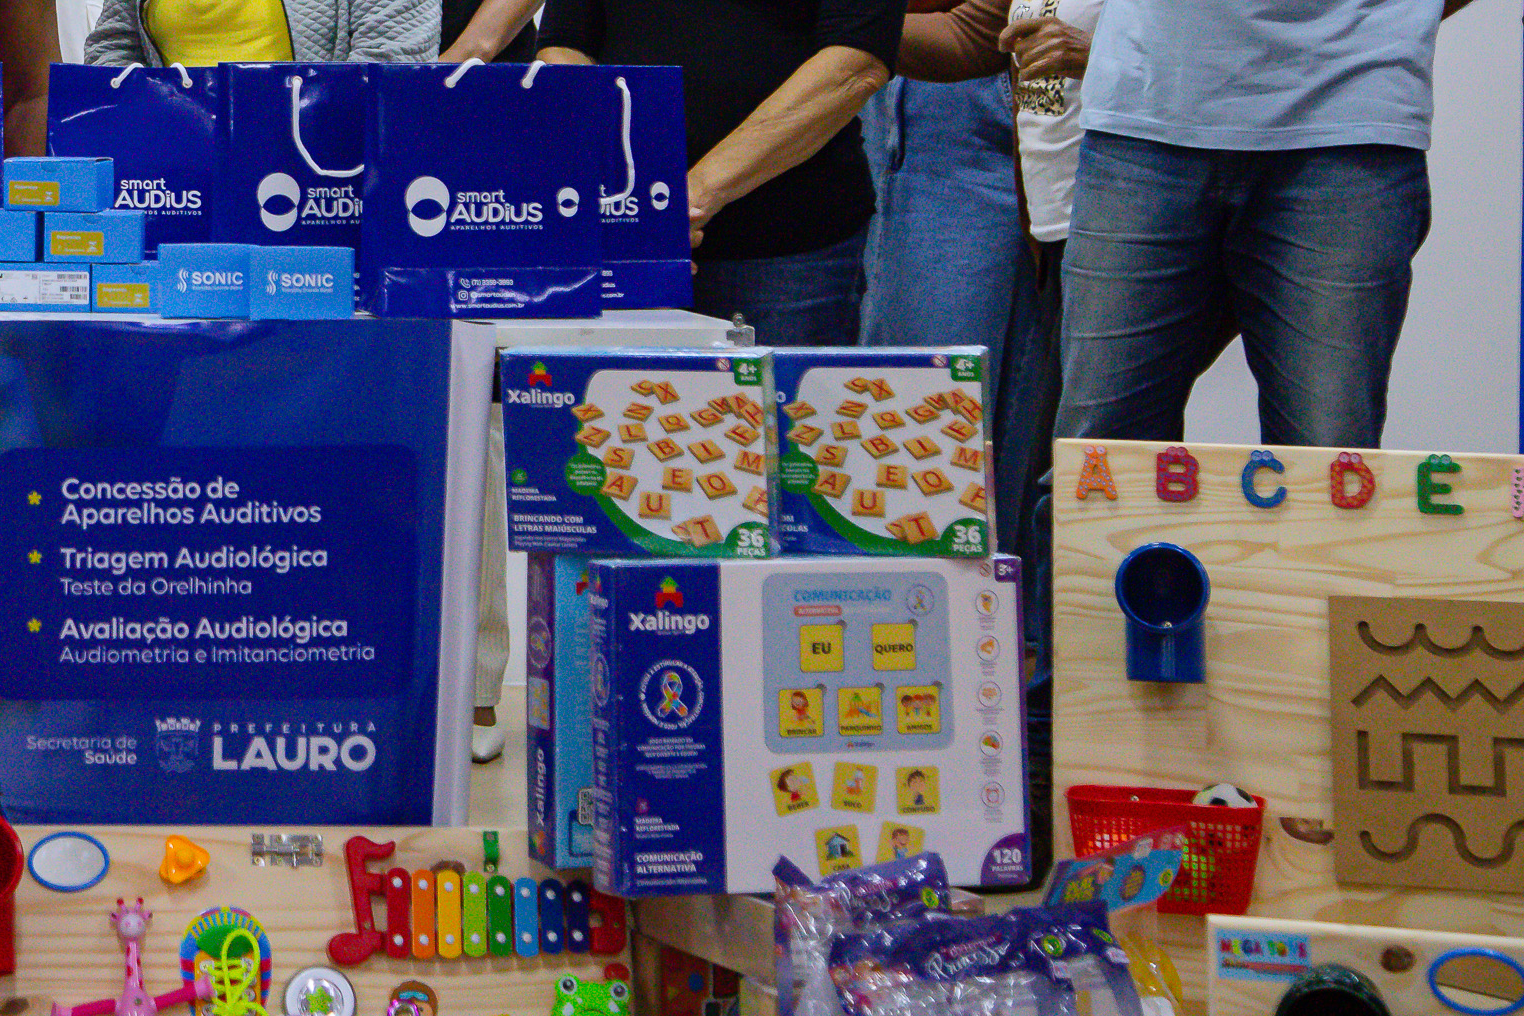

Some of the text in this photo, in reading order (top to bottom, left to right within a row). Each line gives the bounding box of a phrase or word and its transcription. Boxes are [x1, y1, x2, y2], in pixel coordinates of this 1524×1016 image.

[121, 178, 166, 190] smart
[308, 185, 354, 198] smart
[456, 190, 505, 202] smart
[192, 272, 243, 285] SONIC
[281, 274, 333, 287] SONIC
[739, 362, 757, 375] 4+
[955, 359, 975, 370] 4+
[658, 384, 676, 398] X
[874, 381, 890, 397] X
[507, 388, 575, 409] Xalingo
[698, 409, 717, 422] G
[880, 412, 898, 423] Q
[914, 405, 931, 417] G
[667, 416, 683, 427] Q
[839, 423, 853, 434] L
[584, 427, 602, 443] Z
[626, 426, 640, 439] L
[735, 424, 753, 440] F
[795, 425, 813, 439] Z
[949, 422, 968, 436] F
[655, 441, 674, 455] B
[702, 443, 714, 456] I
[870, 438, 889, 453] B
[917, 440, 928, 452] I
[612, 448, 626, 463] S
[822, 446, 838, 460] S
[957, 449, 978, 465] M
[740, 453, 761, 470] M
[672, 469, 683, 485] E
[886, 466, 898, 482] E
[922, 471, 942, 488] O
[1077, 446, 1464, 514] A B C D E
[61, 476, 240, 500] Concessão de
[609, 476, 625, 492] A
[707, 474, 726, 491] O
[818, 474, 837, 490] A
[646, 493, 663, 513] U
[860, 492, 876, 509] U
[61, 501, 321, 530] Aparelhos Auditivos
[513, 514, 562, 523] BRINCANDO
[514, 524, 597, 534] LETRAS MAIÚSCULAS
[693, 521, 712, 538] T
[910, 516, 926, 533] T
[738, 530, 764, 547] 36
[954, 525, 981, 543] 36
[737, 547, 766, 558] PEÇAS
[952, 543, 983, 553] PEÇAS
[60, 545, 328, 575] Triagem Audiológica
[997, 564, 1014, 575] 3+
[60, 576, 252, 596] Teste da Orelhinha
[60, 615, 348, 644] Avaliação Audiológica
[629, 612, 710, 634] Xalingo
[59, 642, 375, 663] Audiometria e Imitanciometria
[812, 642, 832, 654] EU
[874, 643, 914, 655] QUERO
[213, 722, 376, 734] PREFEITURA
[841, 724, 882, 732] PARQUINHO
[26, 736, 137, 750] Secretaria de
[84, 749, 137, 765] Saúde
[213, 735, 376, 771] LAURO
[636, 850, 704, 863] COMUNICAÇÃO
[992, 849, 1022, 864] 120
[636, 864, 697, 874] ALTERNATIVA
